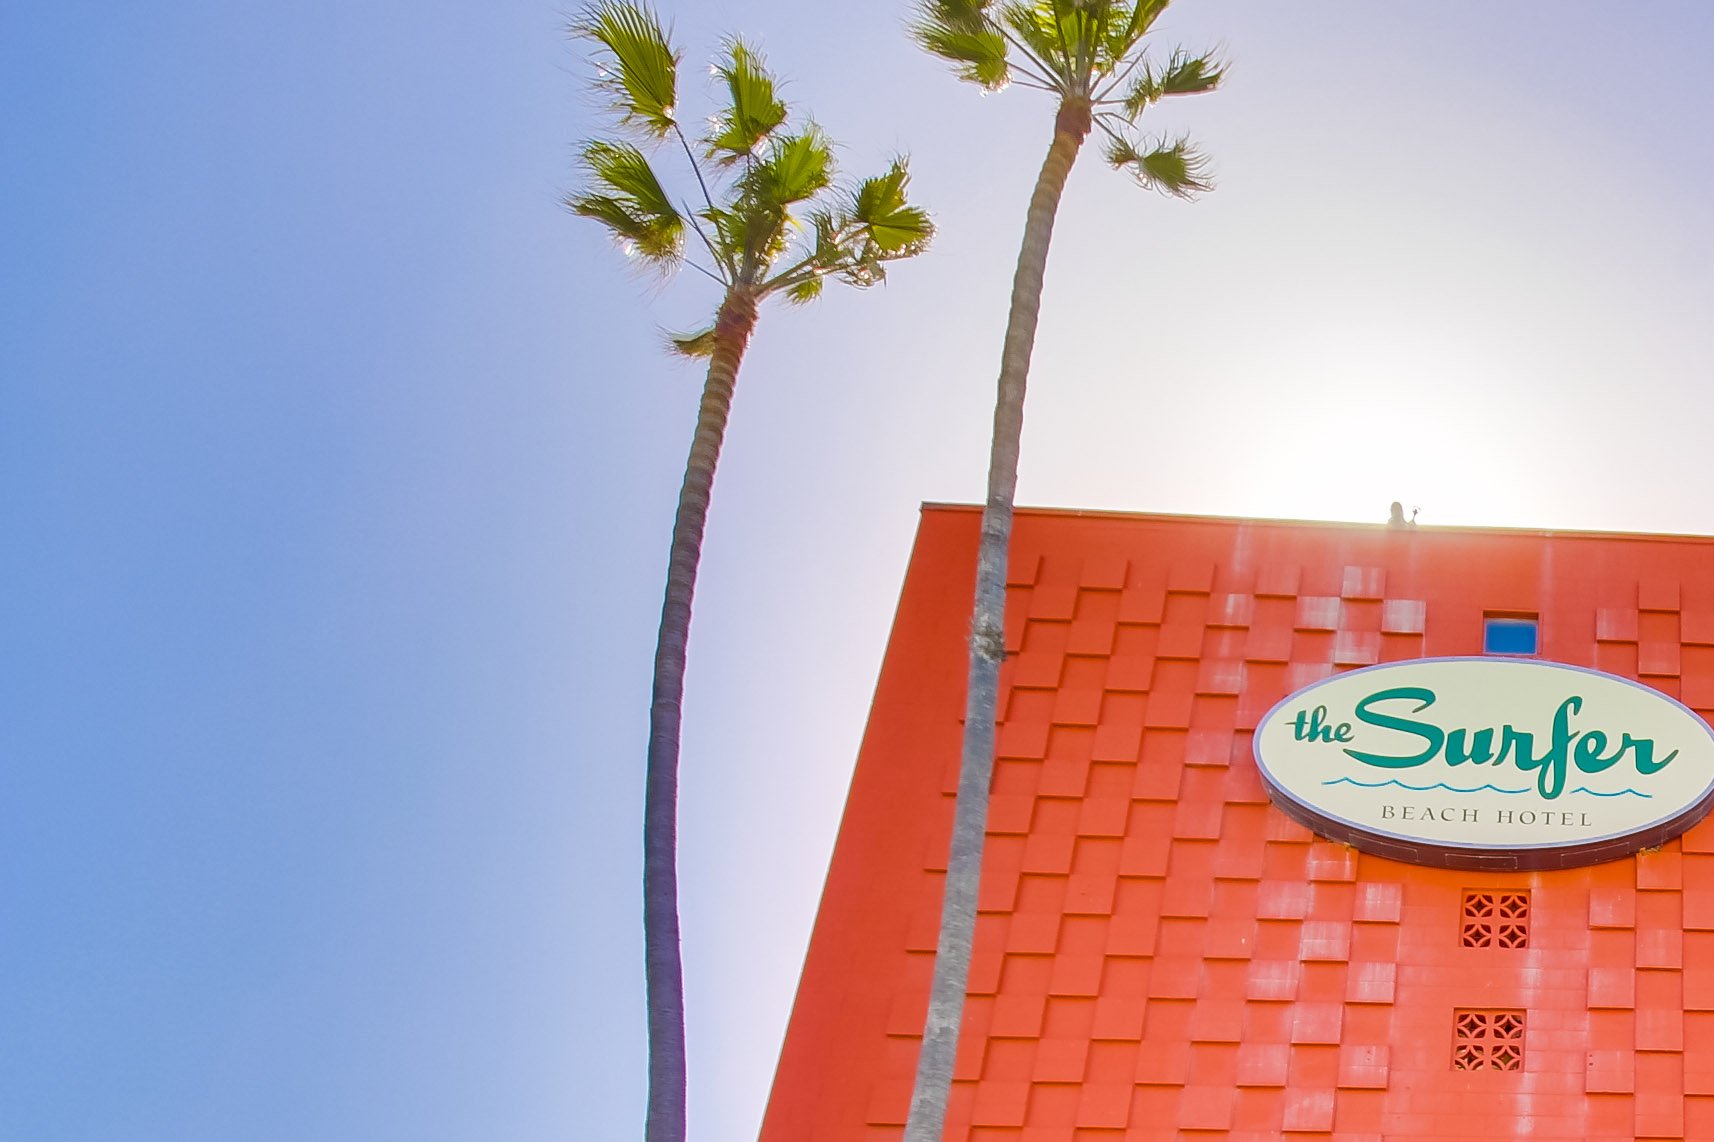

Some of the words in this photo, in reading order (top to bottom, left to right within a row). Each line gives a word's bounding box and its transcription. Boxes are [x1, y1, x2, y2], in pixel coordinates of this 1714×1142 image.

[1285, 705, 1354, 743] the
[1343, 687, 1679, 799] Surfer
[1381, 804, 1480, 823] BEACH
[1497, 810, 1592, 828] HOTEL
